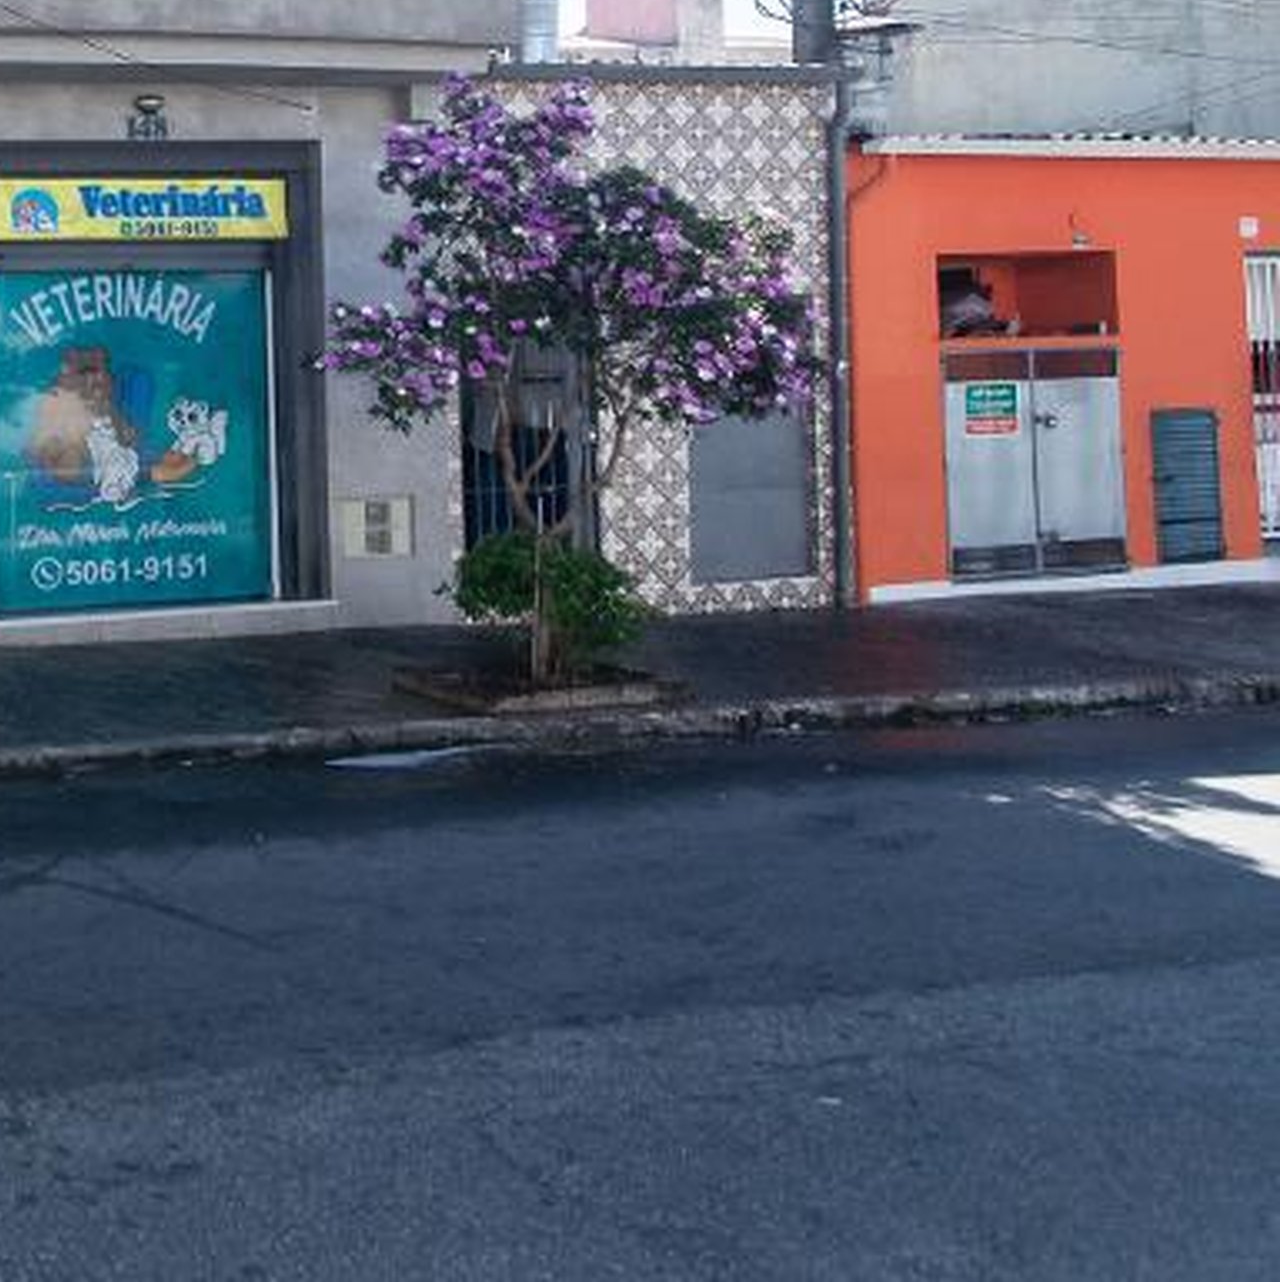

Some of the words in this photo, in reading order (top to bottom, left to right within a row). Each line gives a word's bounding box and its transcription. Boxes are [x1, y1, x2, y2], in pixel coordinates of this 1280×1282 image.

[78, 185, 267, 218] Veterinária
[10, 273, 216, 345] VETERINÁRIA
[66, 554, 208, 586] 5061-9151
